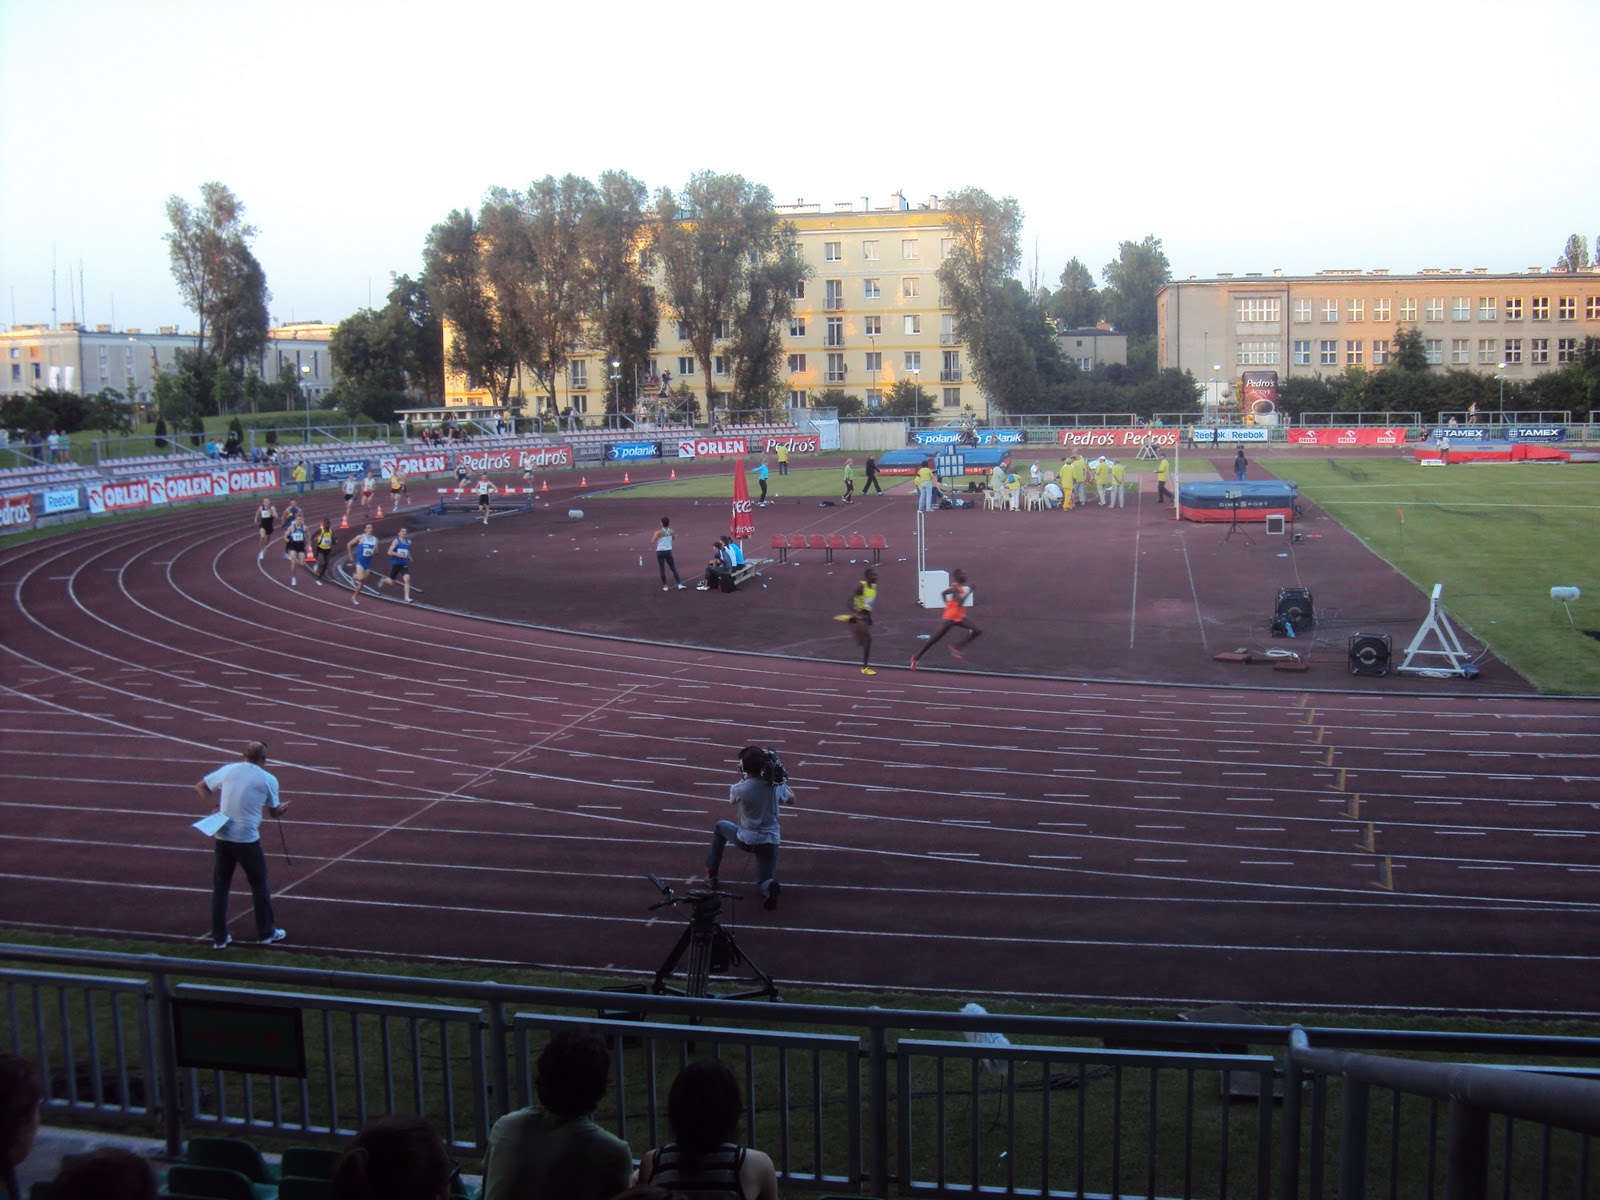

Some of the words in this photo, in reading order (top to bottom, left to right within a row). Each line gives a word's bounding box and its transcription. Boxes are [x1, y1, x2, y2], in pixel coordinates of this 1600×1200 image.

[1246, 378, 1275, 388] Pedro's
[1063, 431, 1115, 445] Pedro's
[1231, 431, 1265, 439] Reebok
[1519, 429, 1559, 437] TAMEX
[697, 440, 744, 455] ORLEN
[463, 452, 511, 470] Pedro's
[328, 462, 364, 473] TAMEX
[104, 483, 150, 507] ORLEN
[166, 476, 212, 498] ORLEN
[230, 470, 277, 491] ORLEN
